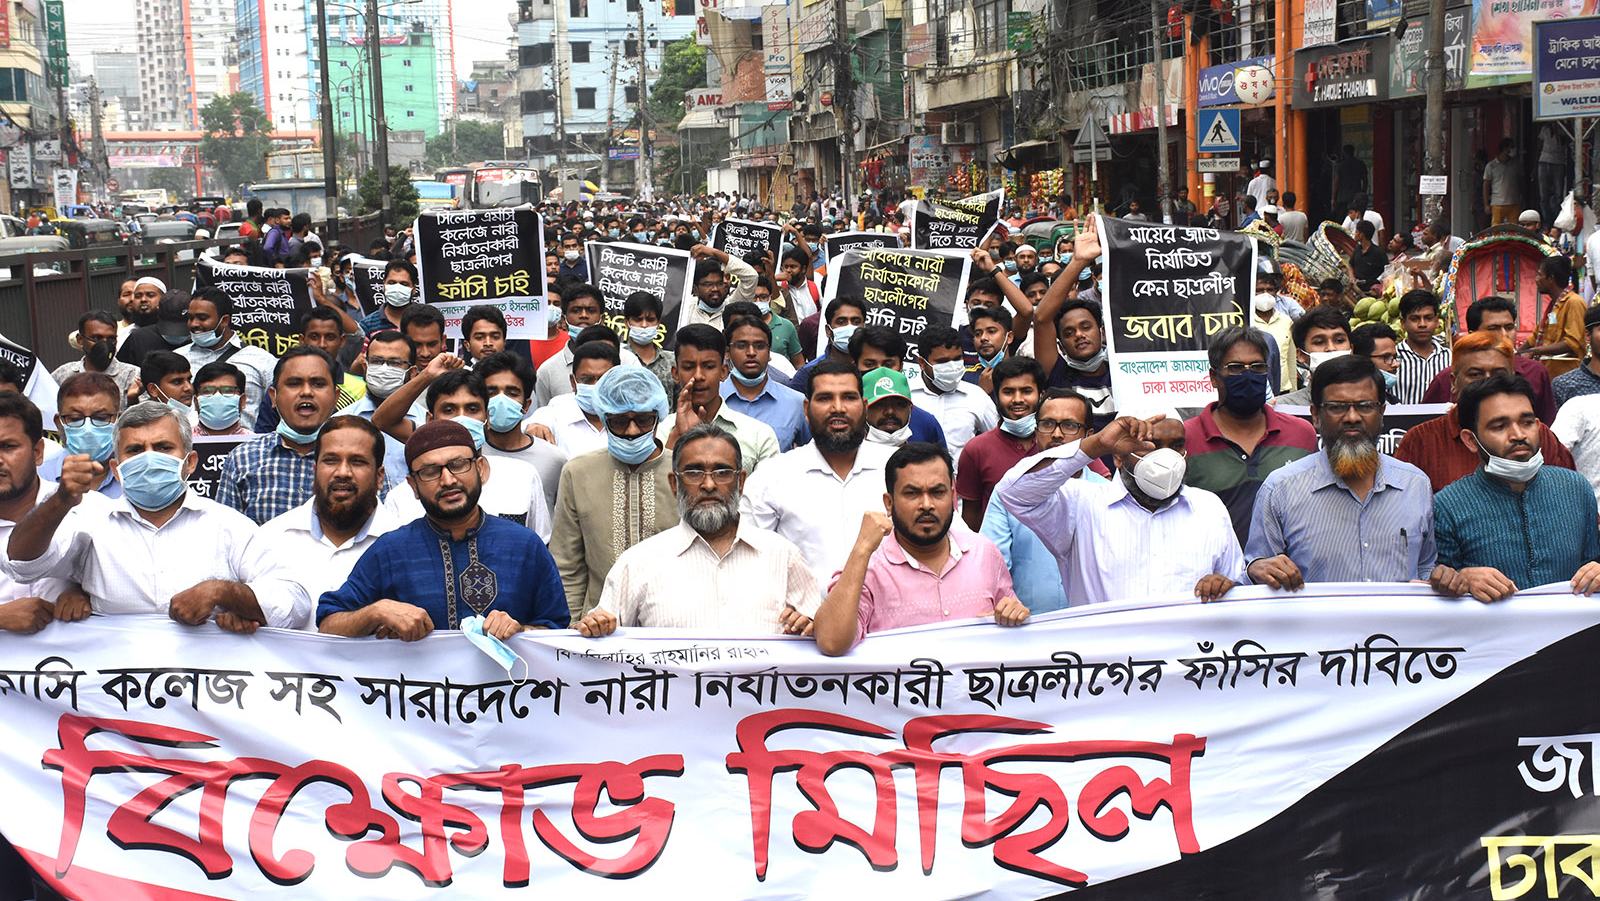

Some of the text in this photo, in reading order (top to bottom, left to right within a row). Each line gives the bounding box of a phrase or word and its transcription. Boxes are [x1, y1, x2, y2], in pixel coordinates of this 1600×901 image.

[771, 10, 780, 54] SINGER
[1548, 36, 1580, 54] ট্রাফিক
[769, 54, 786, 62] Pro
[1555, 57, 1579, 70] মেনে
[1199, 74, 1219, 93] vivo
[1342, 79, 1377, 99] PHARMA
[1560, 96, 1600, 106] WALTO
[934, 207, 981, 225] ছাত্রলীগের
[439, 221, 519, 242] কলেজে নারী
[725, 223, 748, 236] সিলেট
[928, 221, 956, 233] ফাঁসি
[1128, 227, 1176, 245] মায়ের
[441, 235, 519, 259] নির্যাতনকারী
[725, 236, 753, 248] কলেজে
[929, 231, 979, 247] দিতে হবে
[450, 252, 513, 274] ছাত্রলীগের
[600, 249, 669, 272] সিলেট এমসি
[915, 253, 945, 274] নারী
[1145, 248, 1212, 271] নির্যাতিত
[214, 279, 292, 294] কলেজে নারী
[436, 274, 488, 300] ফাঁসি
[494, 269, 531, 297] চাই
[600, 265, 669, 288] কলেজে নারী
[860, 262, 941, 293] নির্যাতনকারী
[1132, 272, 1236, 299] কেন ছাত্রলীগ
[509, 298, 541, 313] ইসলামী
[863, 286, 929, 310] ছাত্রলীগের
[231, 307, 291, 327] ছাত্রলীগের
[504, 315, 526, 328] উত্তর
[899, 315, 928, 336] চাই
[1119, 300, 1245, 344] জবাব চাই
[1119, 360, 1169, 376] বাংলাদেশ
[1142, 381, 1167, 396] ঢাকা
[97, 668, 254, 712] কলেজ
[265, 671, 342, 724] সহ
[354, 675, 570, 724] সারাদেশে
[581, 664, 678, 716] নারী
[691, 657, 953, 709] নির্যাতনকারী
[963, 650, 1168, 711] ছাত্রলীগের
[1178, 640, 1307, 691] ফাঁসির
[1319, 634, 1467, 687] দাবিতে
[42, 708, 1208, 889] বিক্ষোভ মিছিল
